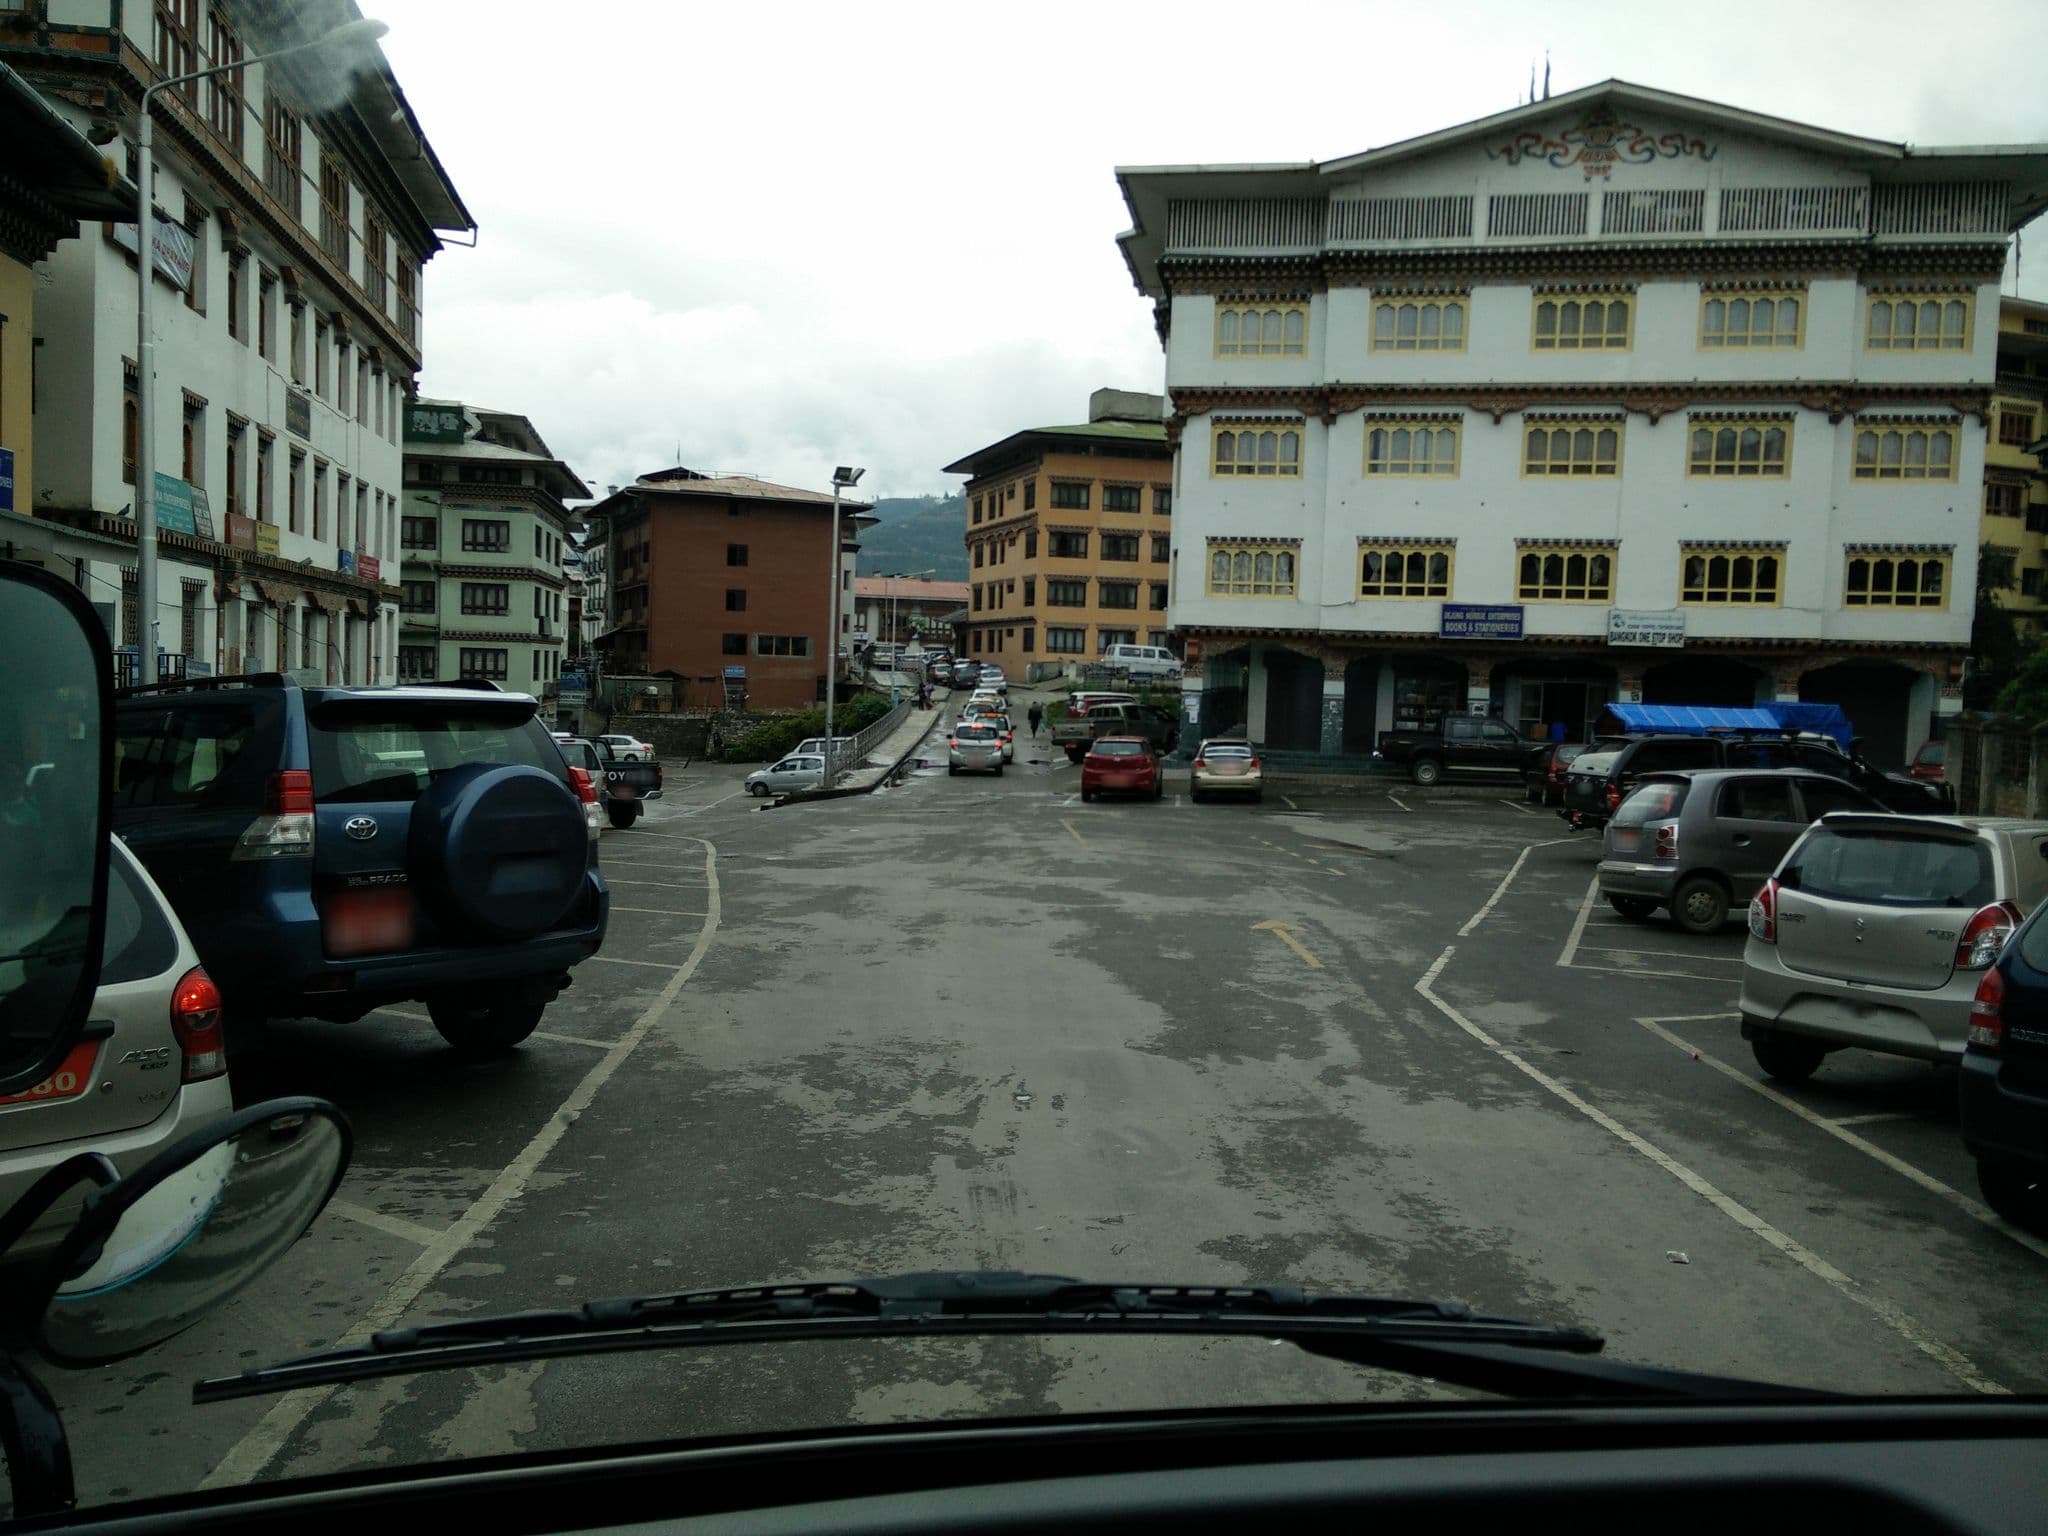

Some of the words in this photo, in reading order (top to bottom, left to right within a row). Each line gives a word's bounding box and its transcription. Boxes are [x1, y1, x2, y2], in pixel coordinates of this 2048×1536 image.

[1445, 622, 1467, 632] BOOKS
[1468, 622, 1474, 632] &
[1474, 622, 1519, 633] STATIONERIES
[1610, 631, 1638, 642] BANGKOK
[1639, 632, 1651, 643] ONE
[1652, 632, 1666, 643] STOP
[1667, 632, 1684, 643] SHOP
[118, 1046, 170, 1064] ALTO
